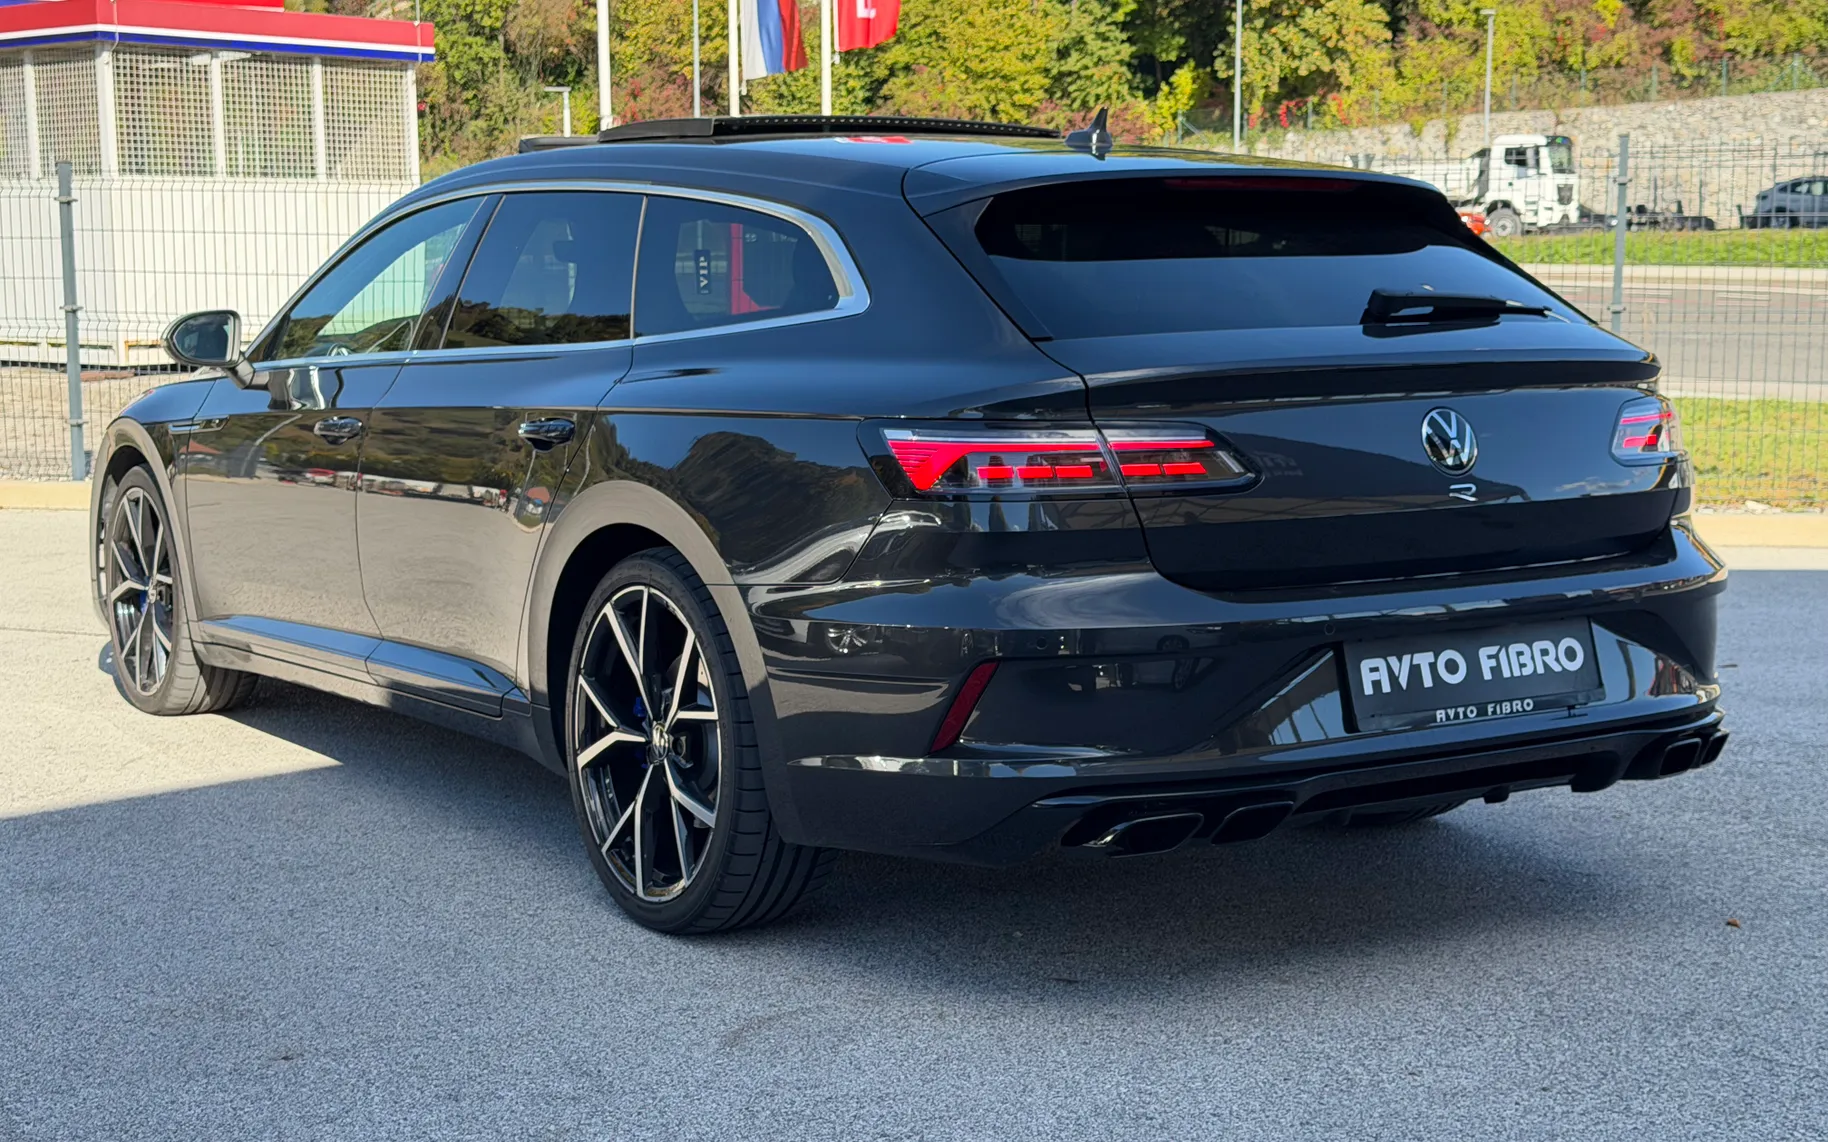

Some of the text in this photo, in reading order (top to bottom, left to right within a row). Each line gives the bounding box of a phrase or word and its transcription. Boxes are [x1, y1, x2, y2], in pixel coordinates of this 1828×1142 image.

[1449, 483, 1478, 502] R
[1360, 637, 1584, 696] AVTO FIBRO
[1436, 698, 1534, 723] AVTO FIBRO
